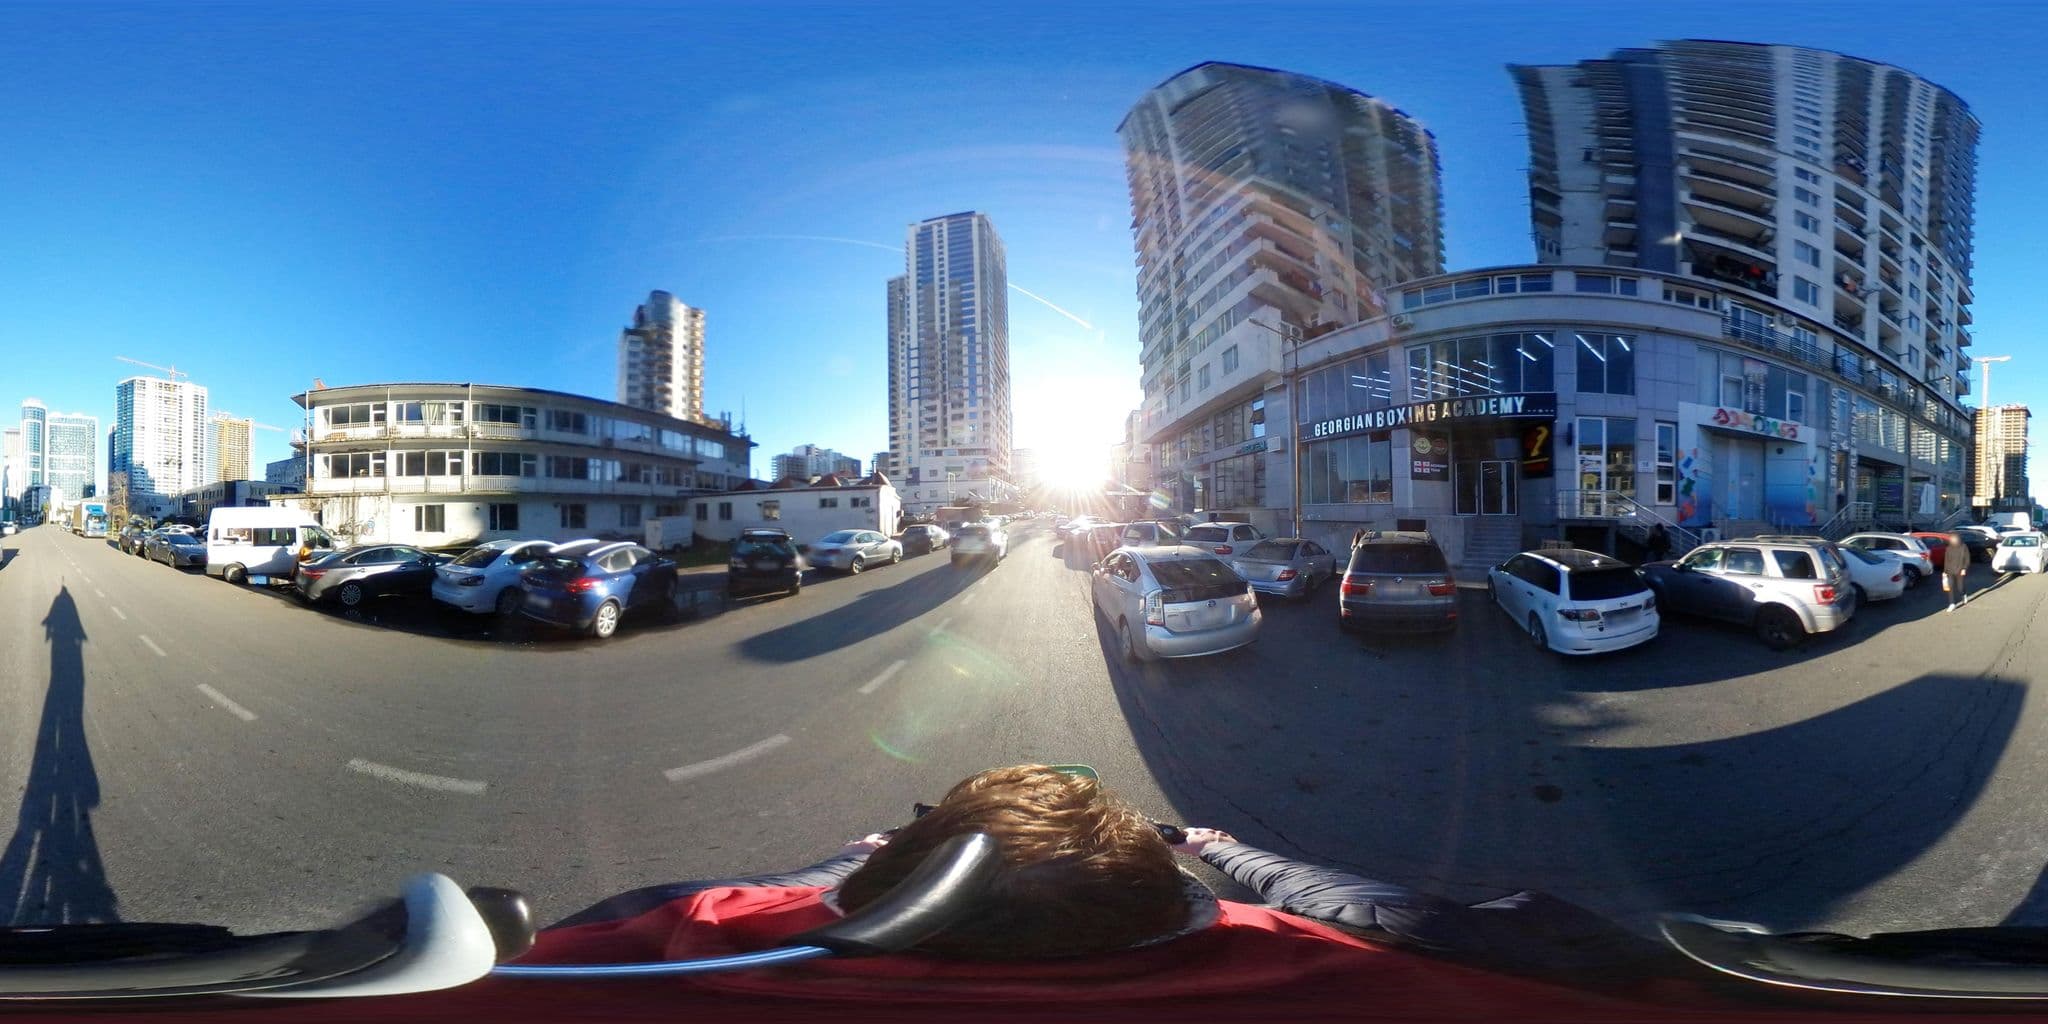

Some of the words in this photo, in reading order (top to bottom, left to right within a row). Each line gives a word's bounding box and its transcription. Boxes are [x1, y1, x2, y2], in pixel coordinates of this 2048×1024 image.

[1314, 414, 1373, 437] GEORGIAN
[1377, 403, 1436, 428] BOXING
[1441, 397, 1525, 418] ACADEMY
